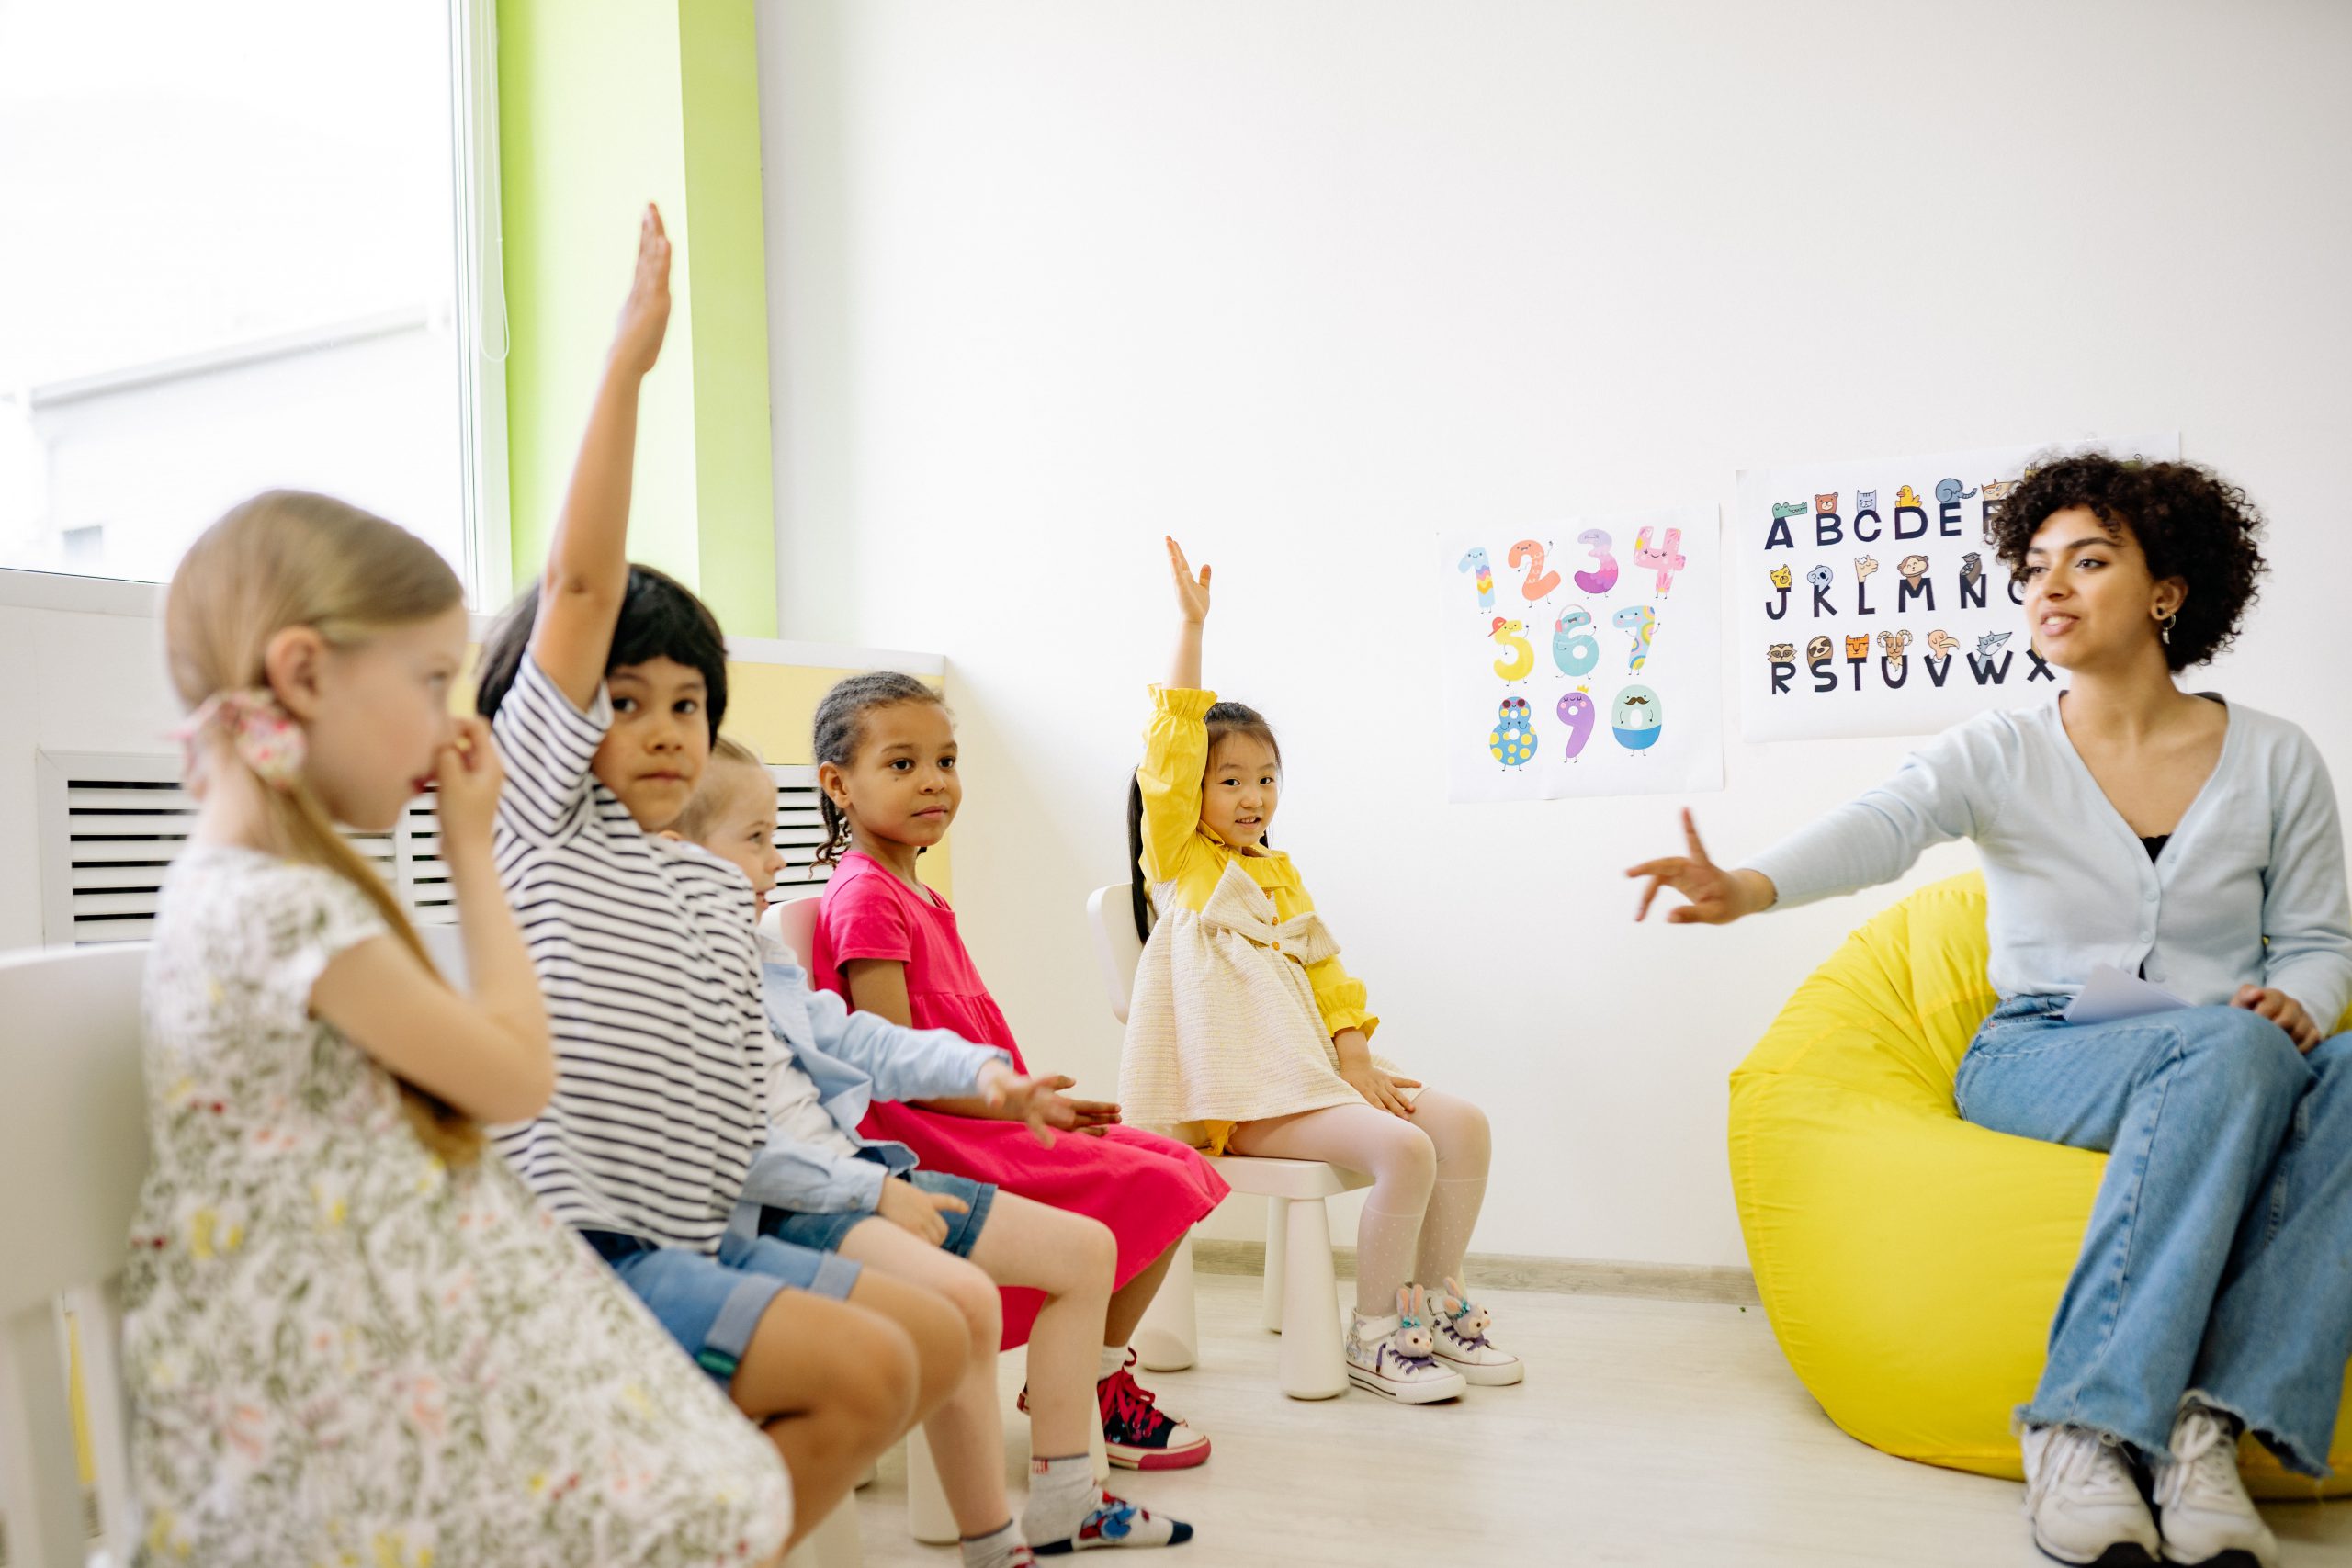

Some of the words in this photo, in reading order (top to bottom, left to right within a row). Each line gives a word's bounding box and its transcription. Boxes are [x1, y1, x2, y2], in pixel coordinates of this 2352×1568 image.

[1764, 517, 1794, 549] A
[1816, 513, 1844, 546] B
[1853, 509, 1882, 542] C
[1894, 506, 1928, 540] D
[1939, 502, 1962, 536] E
[1458, 547, 1496, 608] 1
[1508, 539, 1561, 601] 2
[1574, 528, 1618, 594] 3
[1633, 525, 1686, 593] 4
[1765, 587, 1792, 620] J
[1813, 584, 1838, 617] K
[1858, 581, 1876, 615] L
[1898, 577, 1935, 613] M
[1960, 573, 1986, 609] N
[1493, 619, 1535, 682] 5
[1552, 612, 1600, 677] 6
[1612, 605, 1656, 670] 7
[1771, 661, 1796, 695] R
[1810, 658, 1838, 693] S
[1846, 657, 1867, 691] T
[1881, 654, 1908, 689] U
[1924, 653, 1951, 687] V
[1966, 650, 2013, 685] W
[2026, 649, 2056, 682] X
[1489, 695, 1538, 766] 8
[1556, 692, 1596, 759] 9
[1611, 683, 1663, 750] 0
